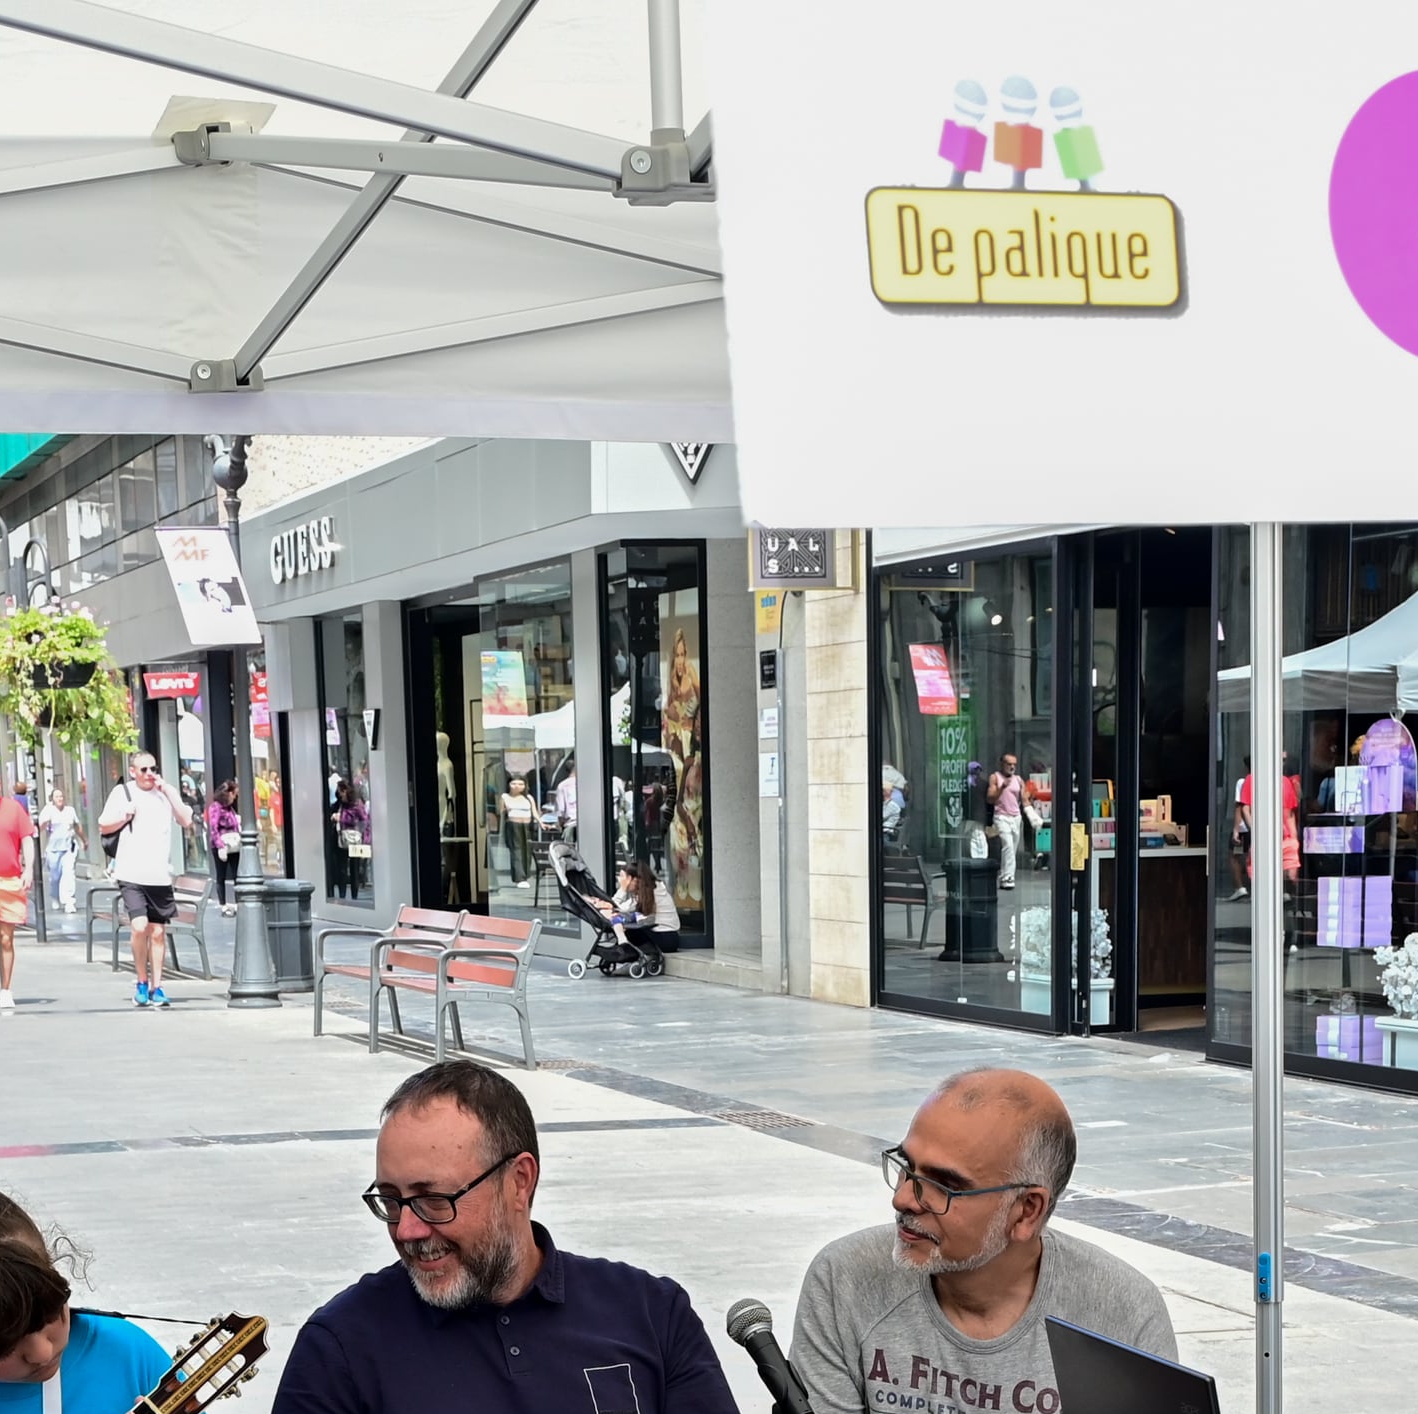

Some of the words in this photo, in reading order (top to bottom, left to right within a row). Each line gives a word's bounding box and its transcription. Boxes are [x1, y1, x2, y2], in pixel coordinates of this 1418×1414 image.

[897, 204, 955, 276] De
[974, 207, 1150, 303] palique
[269, 516, 333, 585] GUESS
[940, 727, 968, 756] 10%
[941, 759, 967, 777] PROFIT
[941, 778, 968, 793] PLEDGE
[867, 1348, 900, 1386] A.
[909, 1354, 1003, 1412] FITCH
